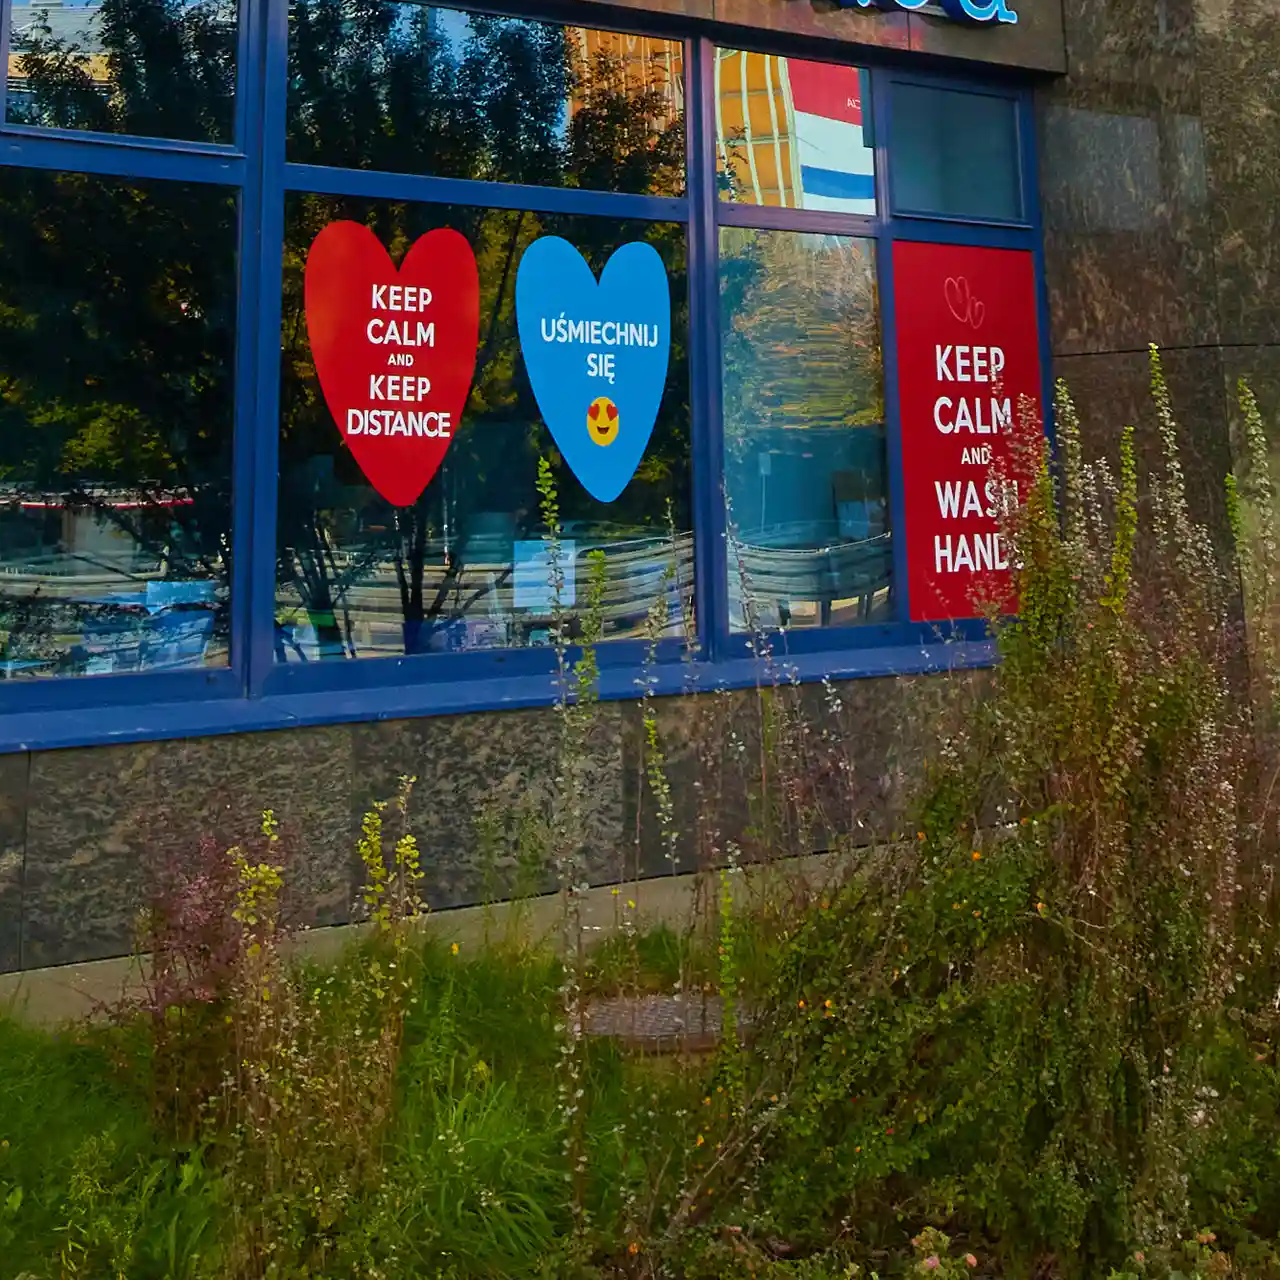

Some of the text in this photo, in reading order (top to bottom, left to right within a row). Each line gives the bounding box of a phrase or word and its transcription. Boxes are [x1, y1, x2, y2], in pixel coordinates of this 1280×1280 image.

[371, 284, 433, 313] KEEP
[366, 318, 435, 348] CALM
[540, 312, 659, 348] UŚMIECHNIJ
[387, 353, 414, 368] AND
[586, 353, 616, 385] SIĘ
[935, 344, 1005, 382] KEEP
[369, 374, 432, 402] KEEP
[347, 409, 451, 438] DISTANCE
[933, 396, 1013, 434] CALM
[961, 447, 989, 465] AND
